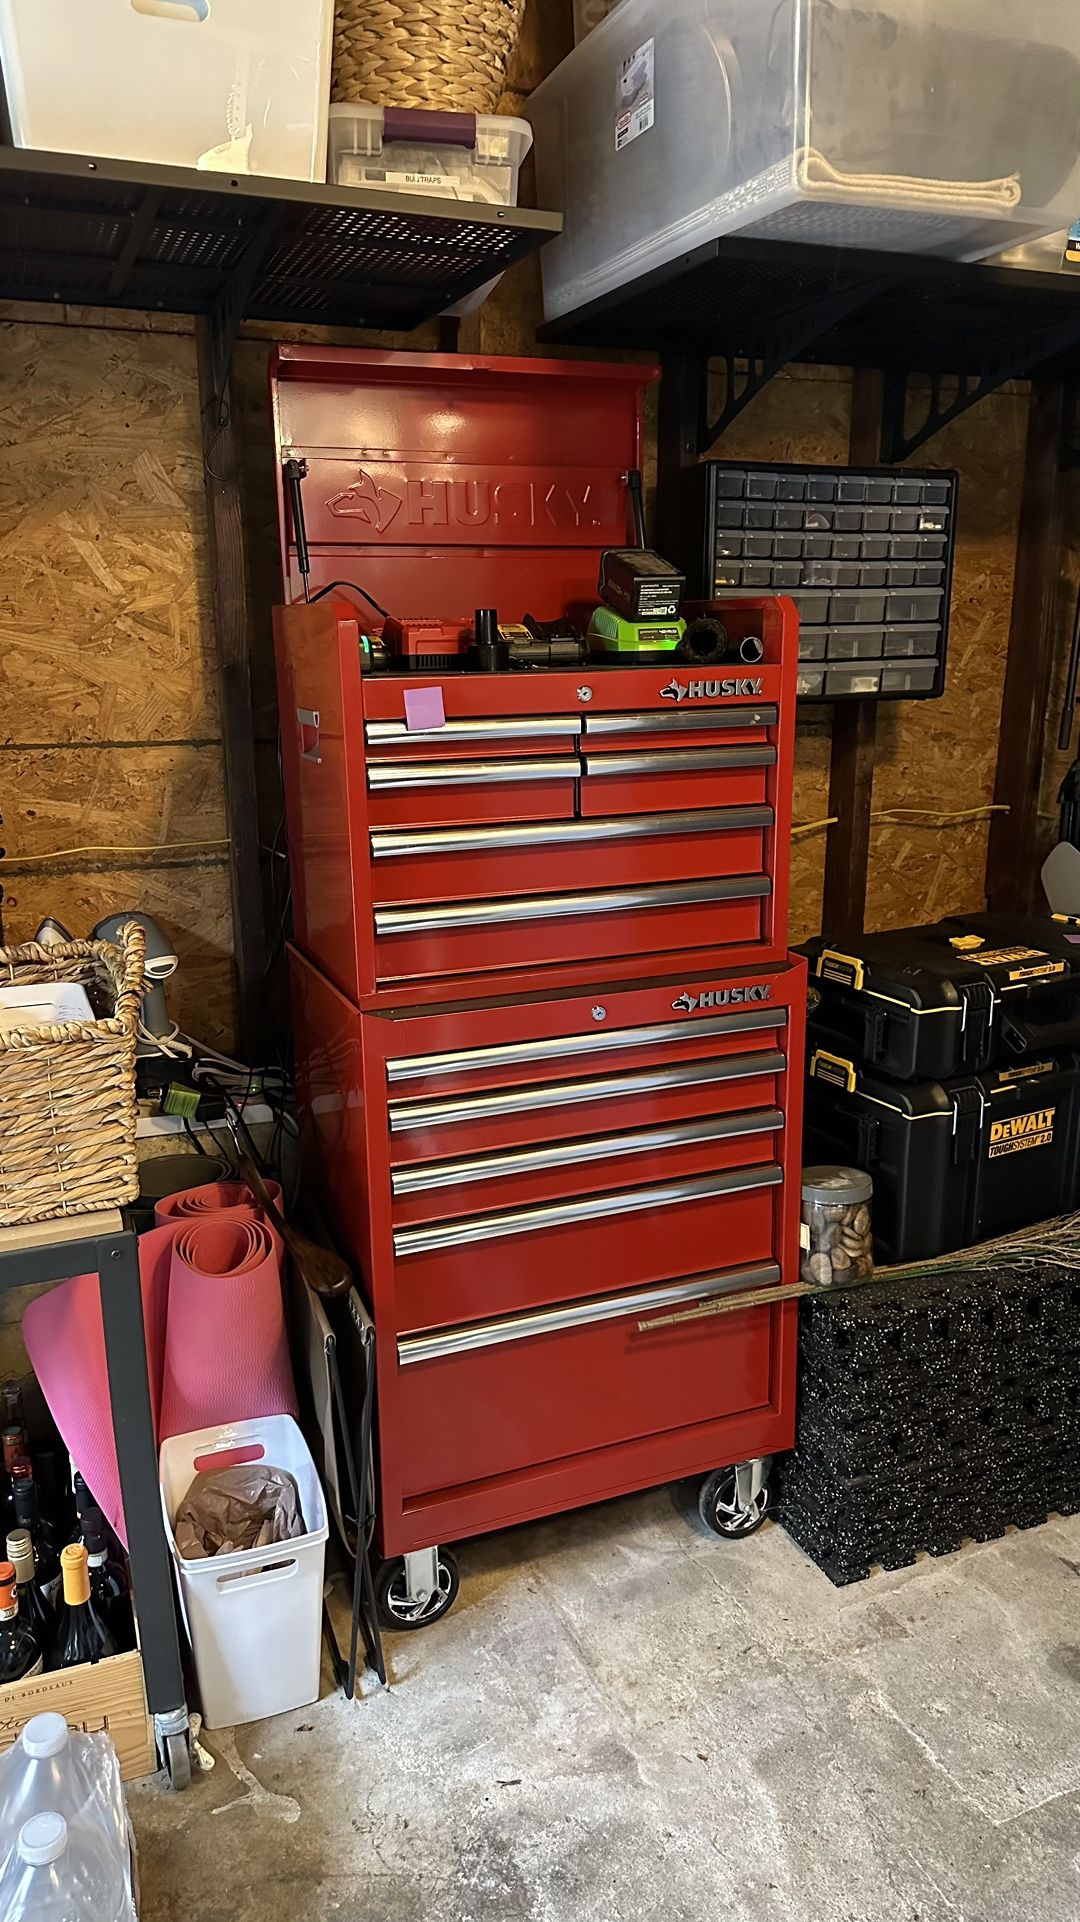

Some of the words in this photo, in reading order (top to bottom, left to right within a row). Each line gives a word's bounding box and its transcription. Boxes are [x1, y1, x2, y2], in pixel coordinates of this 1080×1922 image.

[420, 176, 442, 184] TRAPS
[406, 479, 597, 527] HUSKY
[688, 678, 763, 698] HUSKY
[699, 985, 771, 1008] HUSKY
[990, 1109, 1056, 1142] DEWALT
[989, 1136, 1038, 1157] TOUGHSYSTEM
[1040, 1132, 1052, 1144] 2.0
[21, 1680, 74, 1698] BORDEAUX
